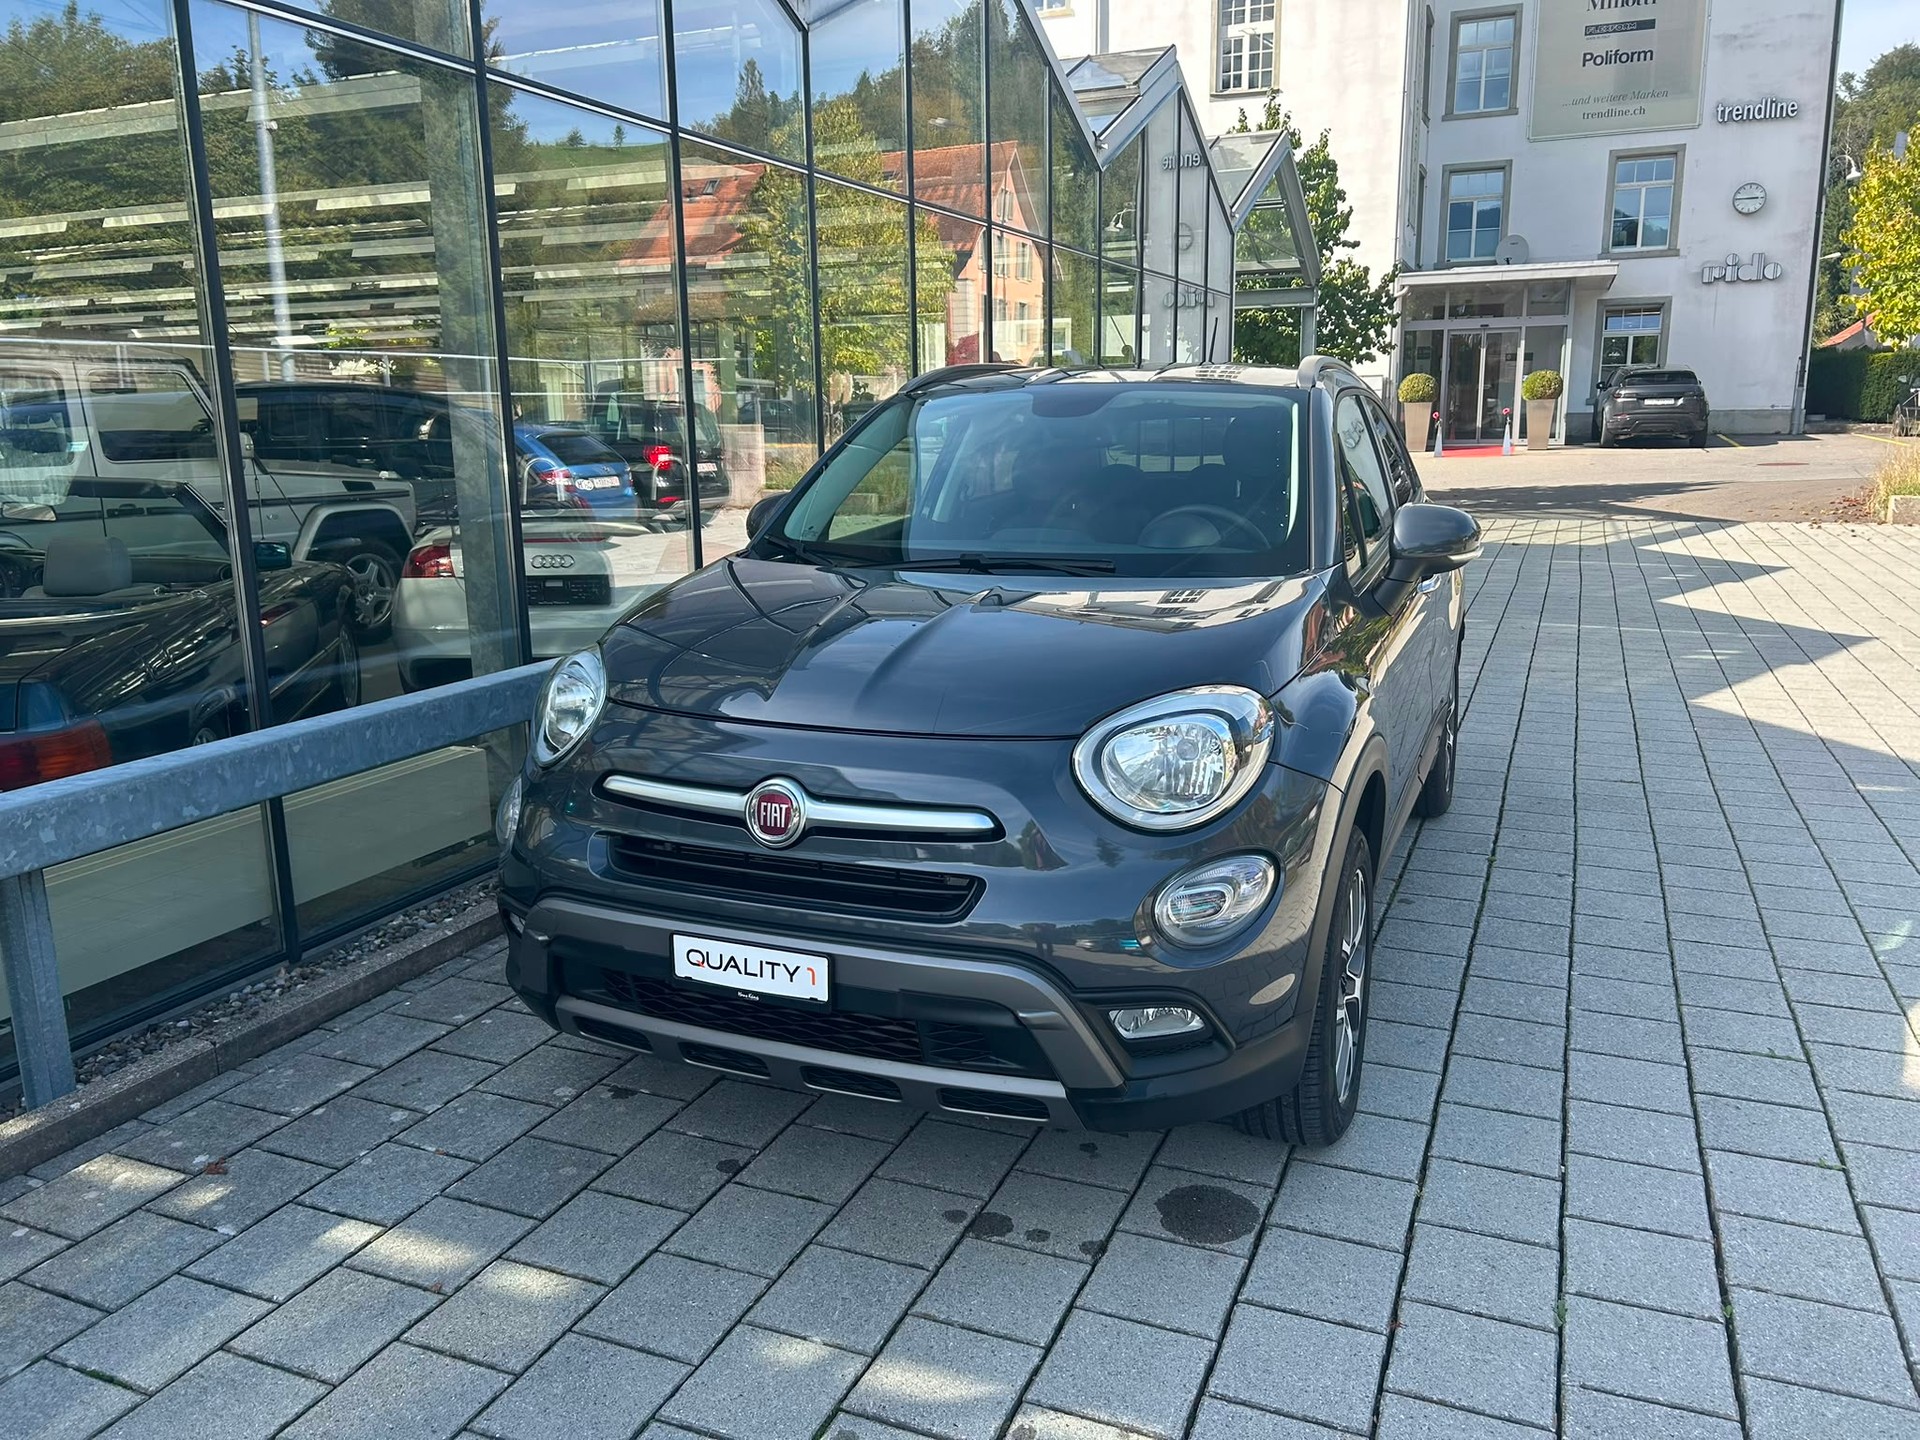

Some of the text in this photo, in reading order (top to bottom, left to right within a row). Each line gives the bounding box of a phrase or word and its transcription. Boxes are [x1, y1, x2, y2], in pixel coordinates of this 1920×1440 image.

[1582, 48, 1654, 67] Poliform
[1593, 92, 1629, 104] weitere
[1630, 89, 1669, 101] Marken
[1582, 106, 1646, 120] trendline.ch
[1716, 97, 1798, 122] trendline
[760, 802, 788, 828] FIAT
[686, 949, 801, 983] QUALITY
